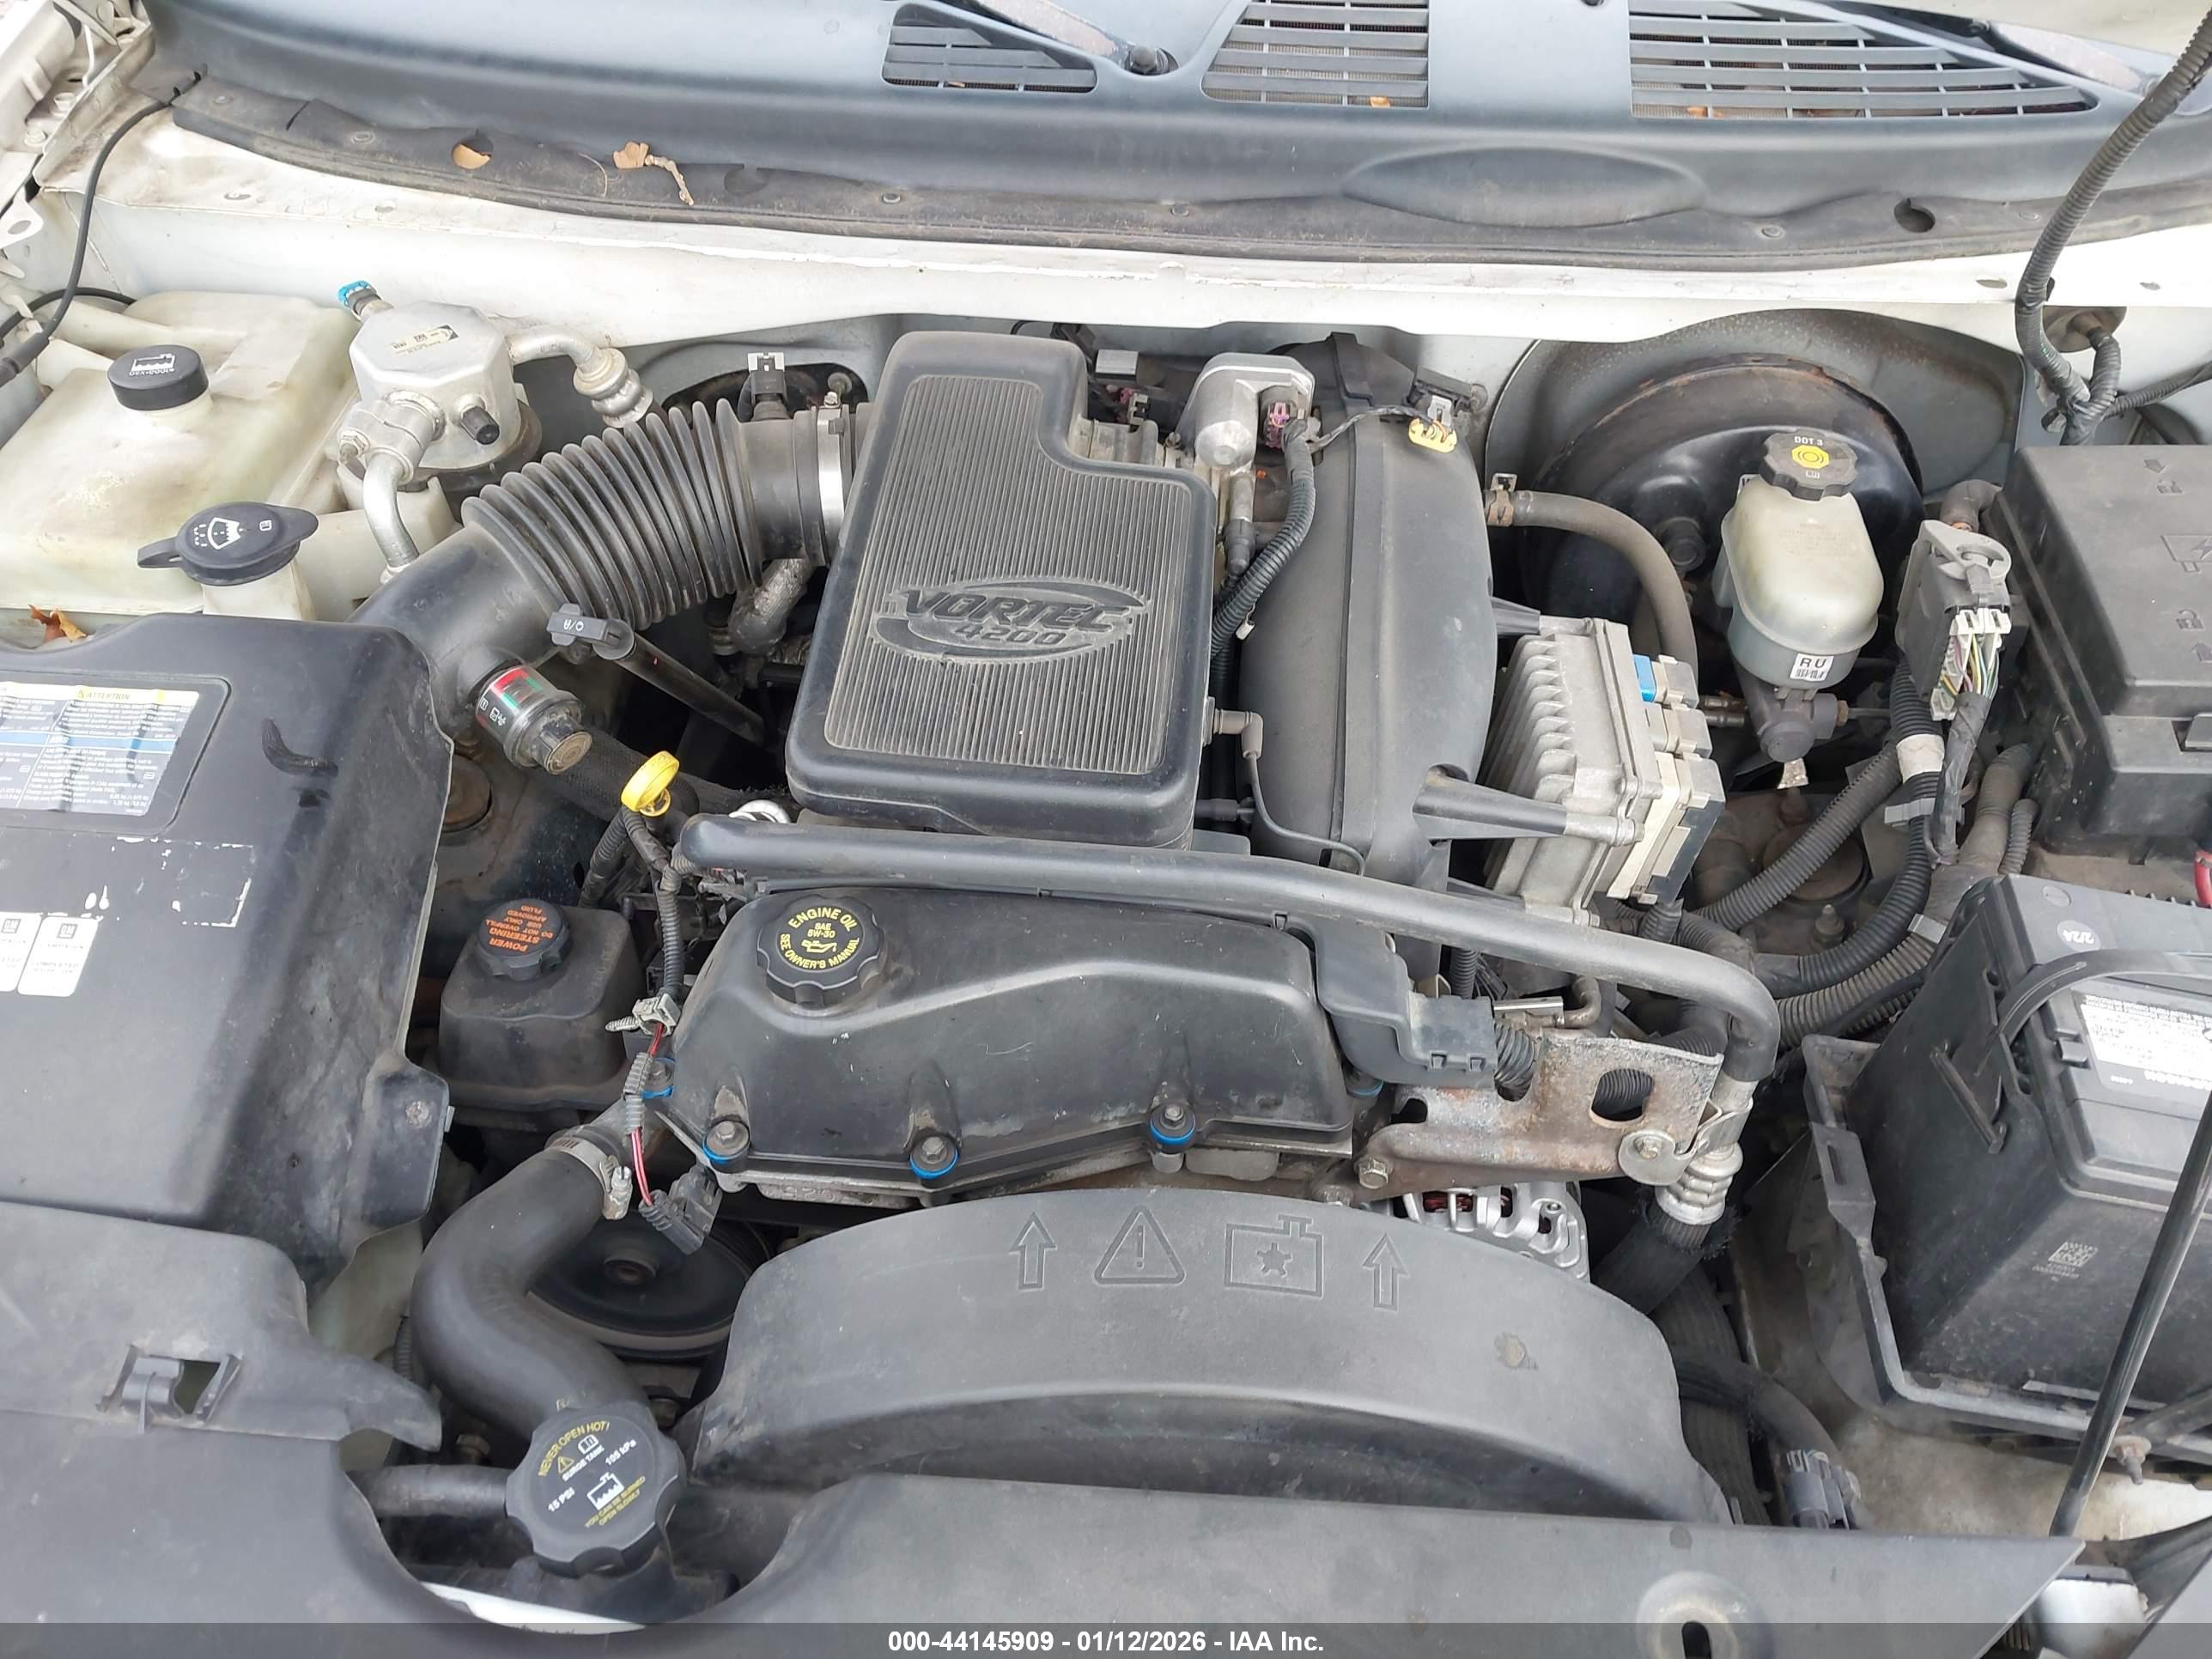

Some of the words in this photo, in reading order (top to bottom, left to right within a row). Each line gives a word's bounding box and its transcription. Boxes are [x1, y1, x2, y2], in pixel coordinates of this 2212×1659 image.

[1794, 435, 1814, 445] DOT
[902, 589, 1131, 633] VORTEC
[954, 624, 1066, 646] 4200
[507, 909, 547, 922] APPROVED
[520, 905, 543, 915] FLUID
[503, 916, 523, 925] ONLY
[788, 907, 842, 928] ENGINE
[840, 914, 858, 932] OIL
[489, 927, 540, 944] STEERING
[781, 933, 792, 951] SEE
[807, 929, 836, 939] 5W-30
[489, 938, 529, 952] POWER
[828, 937, 860, 967] MANUAL
[784, 950, 826, 969] OWNER'S
[538, 1443, 562, 1477] NEVER
[558, 1425, 586, 1447] OPEN
[586, 1420, 611, 1434] HOT!
[605, 1450, 621, 1466] 105
[618, 1439, 637, 1455] kPa
[562, 1458, 587, 1482] SURGE
[585, 1444, 605, 1462] TANK
[548, 1499, 560, 1511] 15
[558, 1486, 575, 1504] PSI
[584, 1514, 599, 1528] YOU
